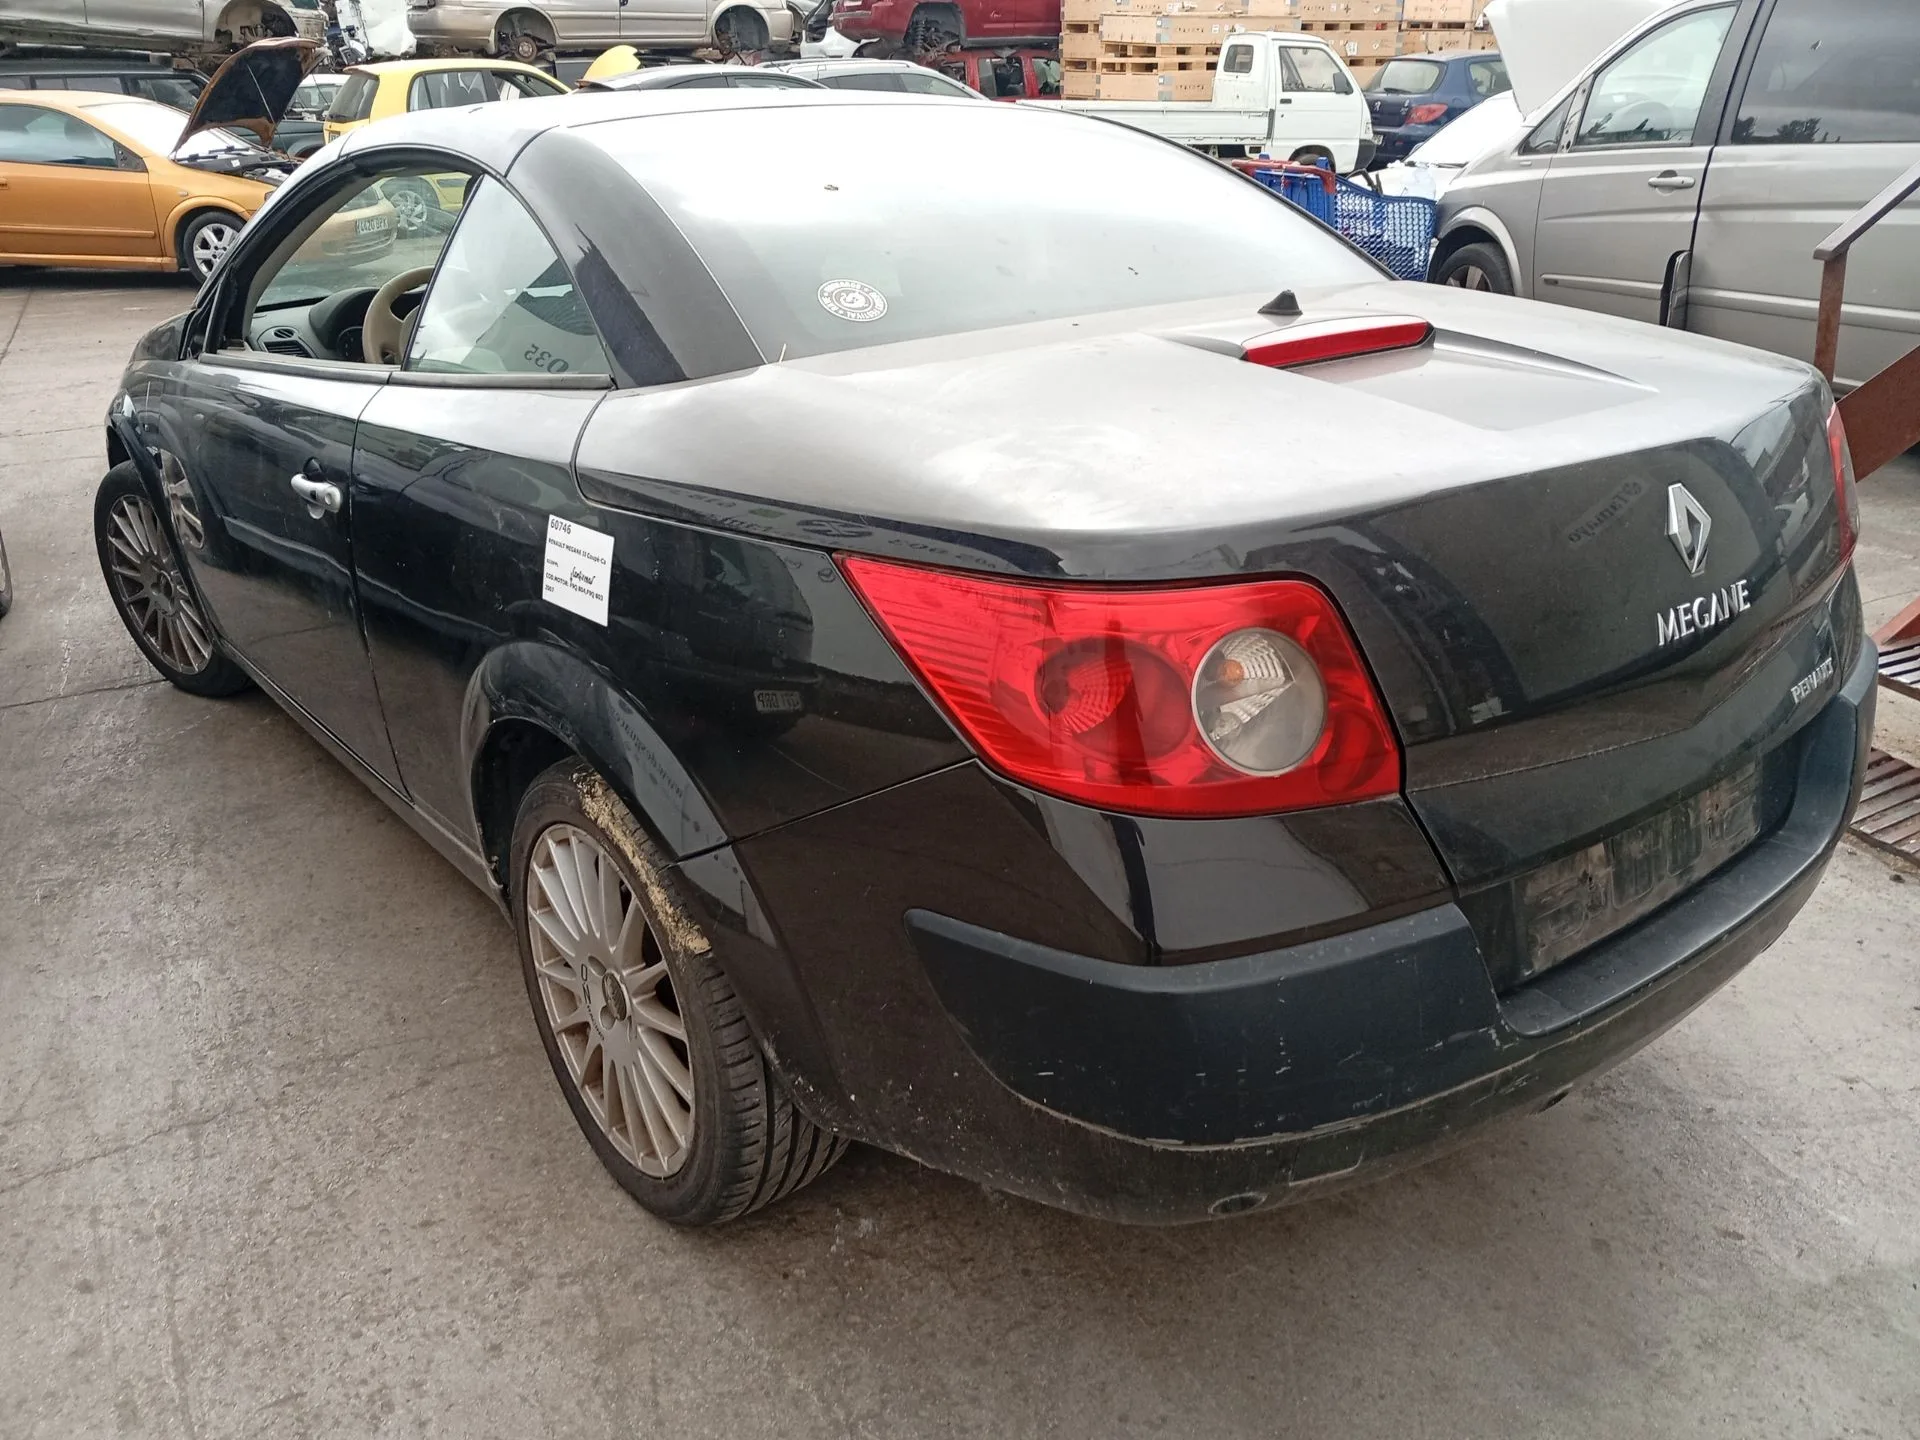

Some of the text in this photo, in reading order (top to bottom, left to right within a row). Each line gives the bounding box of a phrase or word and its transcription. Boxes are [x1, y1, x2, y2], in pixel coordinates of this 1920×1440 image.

[550, 518, 572, 535] 60746
[548, 537, 566, 549] RENAULT
[565, 544, 582, 556] MEGANE
[1656, 579, 1751, 646] MEGANE
